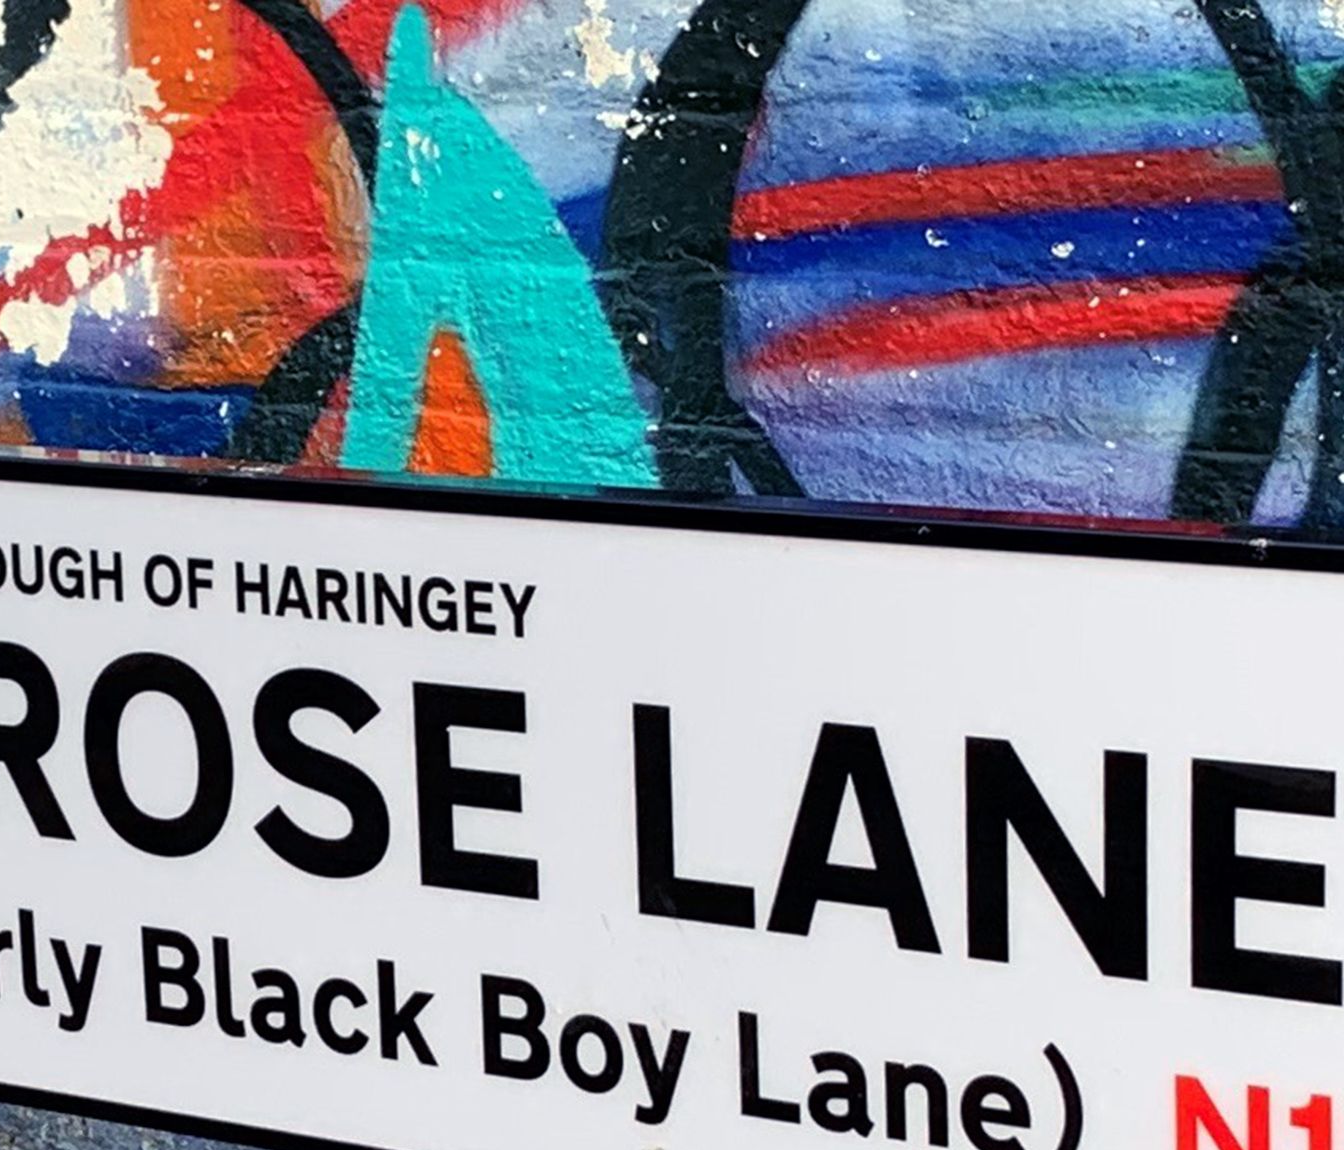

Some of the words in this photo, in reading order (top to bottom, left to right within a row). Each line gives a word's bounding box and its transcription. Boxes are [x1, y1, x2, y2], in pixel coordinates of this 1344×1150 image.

[143, 554, 214, 610] OF
[235, 561, 537, 638] HARINGEY
[632, 702, 1344, 1007] LANE
[140, 925, 439, 1067] Black
[480, 973, 691, 1126] Boy
